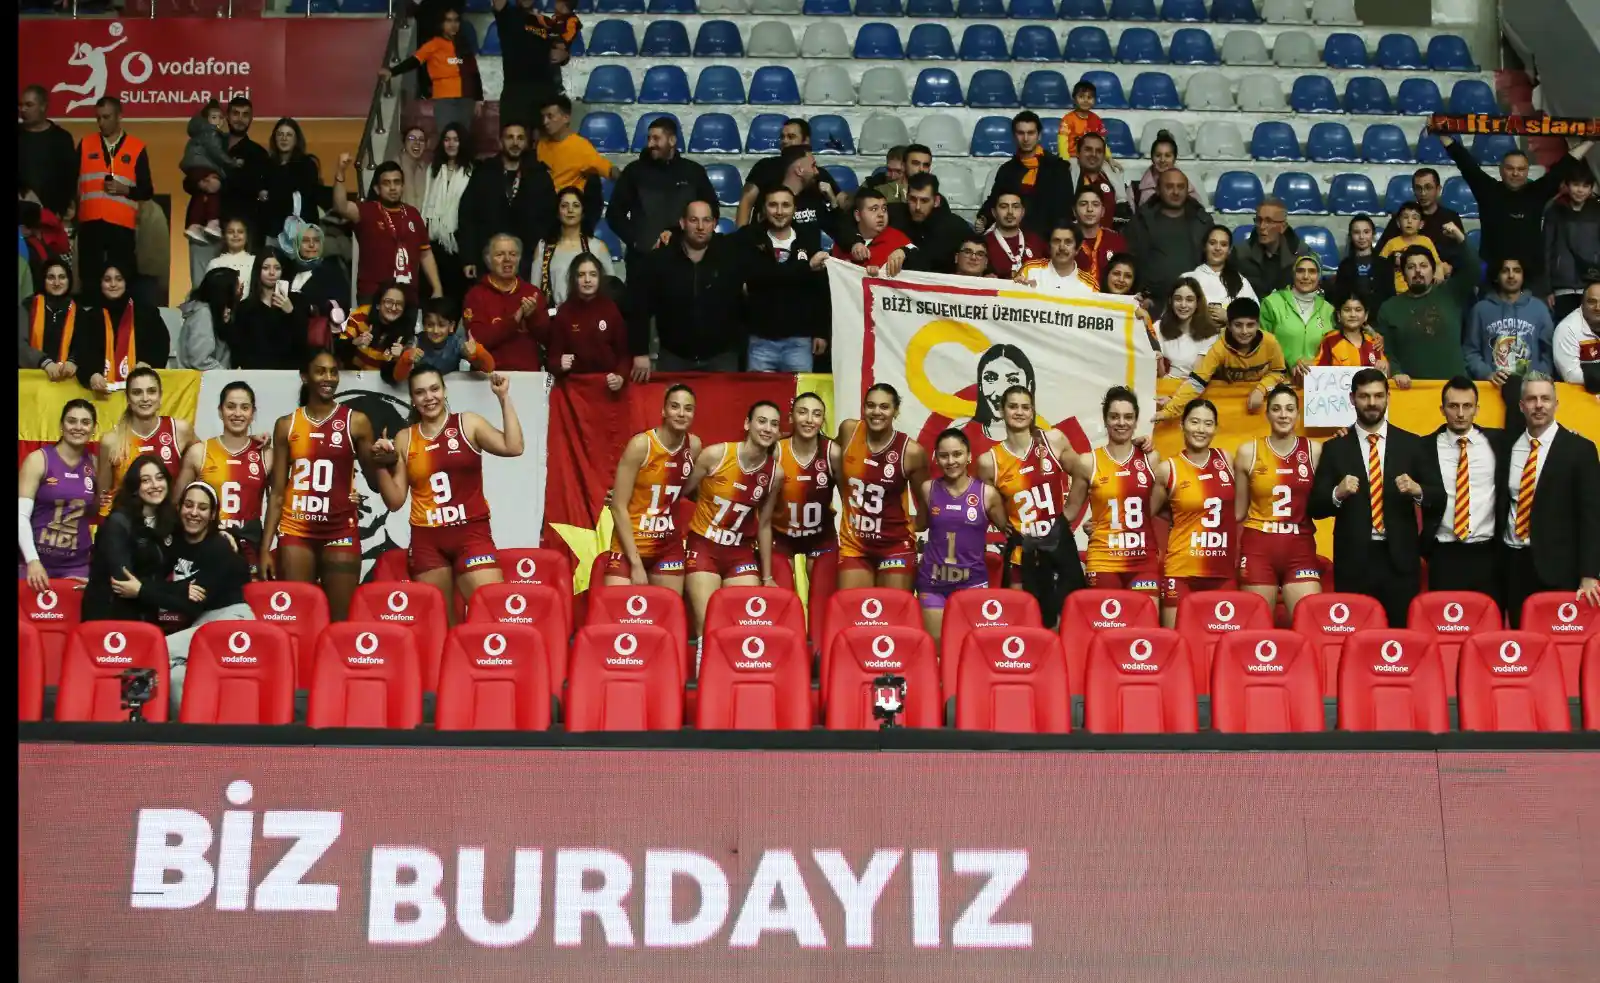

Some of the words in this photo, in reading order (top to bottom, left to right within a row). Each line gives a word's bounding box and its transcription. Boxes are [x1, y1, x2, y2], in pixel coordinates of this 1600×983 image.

[158, 57, 251, 76] vodafone
[120, 90, 212, 104] SULTANLAR
[882, 294, 913, 313] BİZİ
[992, 304, 1074, 328] ÜZMEYELİM
[1077, 314, 1114, 331] BABA
[293, 458, 334, 493] 20
[429, 471, 452, 505] 9
[848, 476, 886, 514] 33
[221, 481, 241, 514] 6
[292, 495, 330, 513] HDI
[647, 484, 682, 515] 17
[1013, 482, 1056, 522] 24
[1272, 484, 1292, 516] 2
[47, 499, 86, 534] 12
[425, 503, 467, 525] HDI
[711, 494, 752, 531] 77
[787, 501, 822, 528] 10
[1107, 496, 1143, 529] 18
[1201, 497, 1222, 528] 3
[639, 513, 676, 532] HDI
[704, 523, 744, 547] HDI
[1108, 531, 1146, 549] HDI
[1190, 531, 1228, 548] HDI
[944, 531, 957, 564] 1
[1168, 578, 1176, 590] 3
[31, 611, 64, 620] vodafone
[263, 612, 297, 621] vodafone
[380, 612, 414, 621] vodafone
[499, 615, 533, 624] vodafone
[739, 618, 773, 626] vodafone
[1093, 619, 1127, 628] vodafone
[1208, 622, 1241, 631] vodafone
[1323, 624, 1356, 632] vodafone
[1437, 623, 1470, 632] vodafone
[1551, 623, 1584, 632] vodafone
[96, 655, 133, 664] vodafone
[221, 655, 258, 663] vodafone
[348, 656, 385, 665] vodafone
[476, 657, 513, 665] vodafone
[606, 656, 644, 666] vodafone
[735, 659, 772, 669] vodafone
[864, 658, 902, 668] vodafone
[994, 659, 1031, 669] vodafone
[1122, 661, 1159, 671] vodafone
[1248, 663, 1284, 672] vodafone
[1373, 663, 1409, 673] vodafone
[1492, 664, 1528, 673] vodafone
[130, 779, 343, 911] BİZ
[368, 844, 1034, 949] BURDAYIZ
